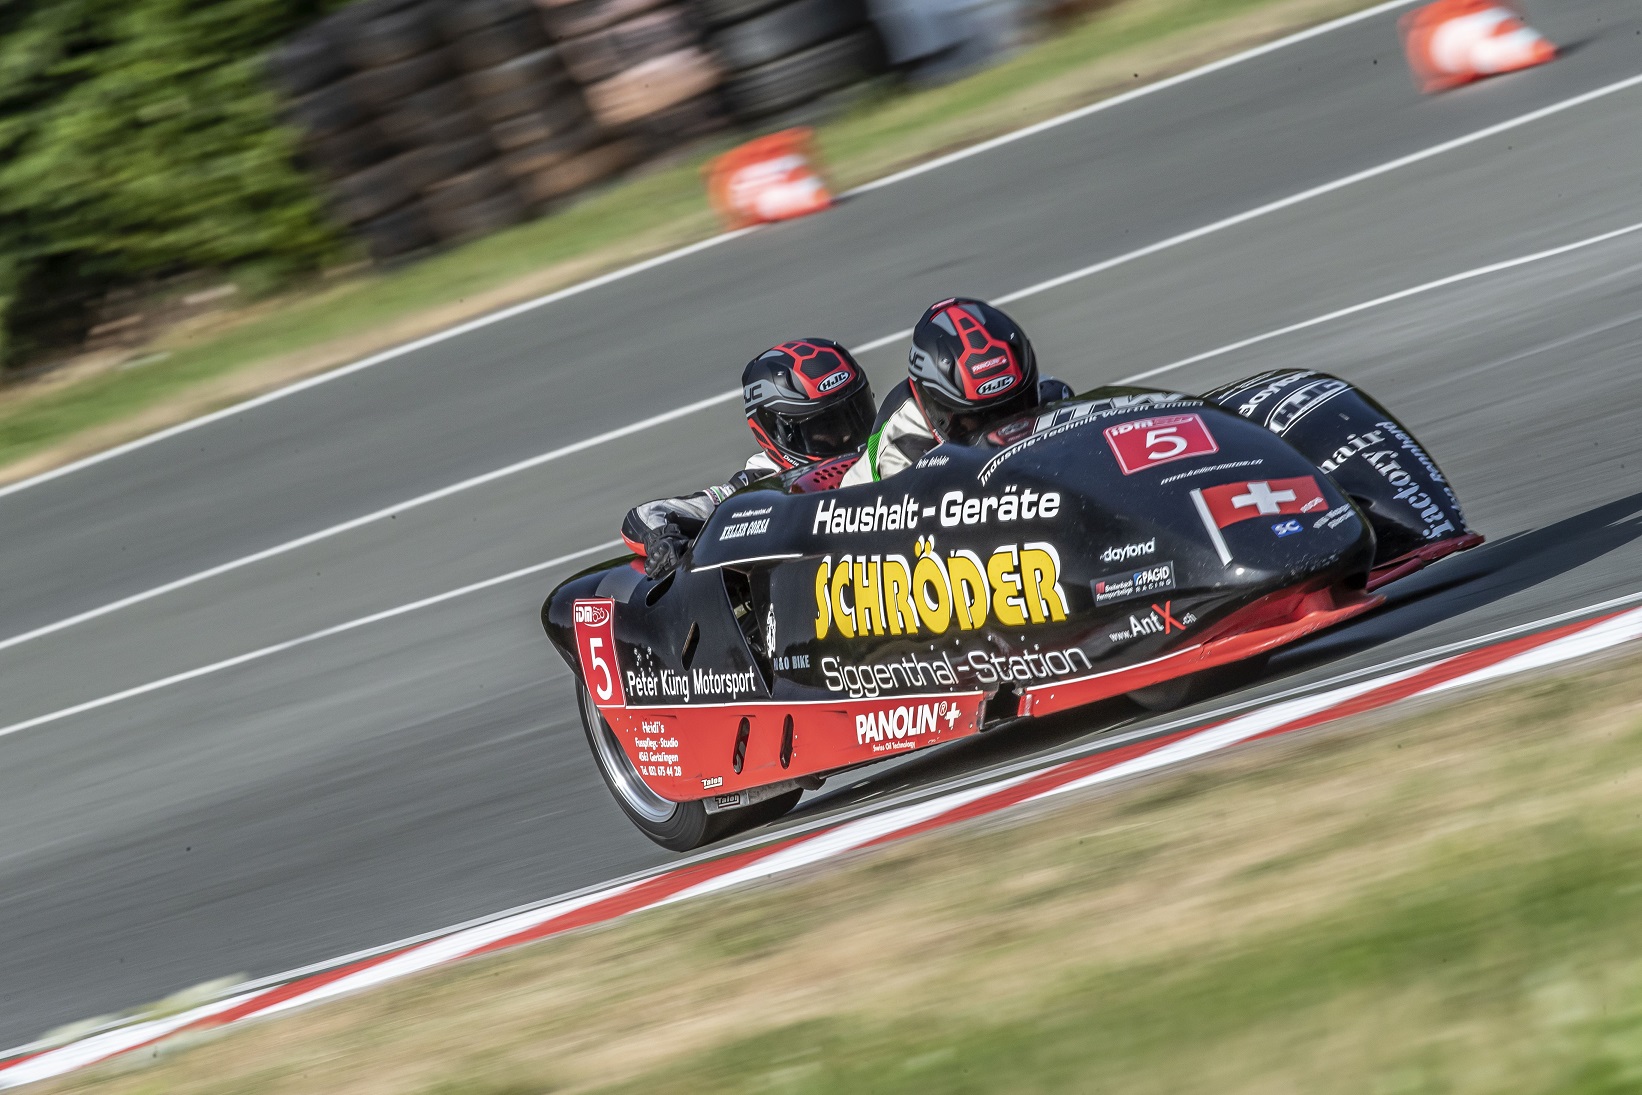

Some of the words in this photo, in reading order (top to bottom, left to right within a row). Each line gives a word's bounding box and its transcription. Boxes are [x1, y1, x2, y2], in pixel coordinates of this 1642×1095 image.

[821, 371, 847, 390] HJC
[981, 377, 1010, 393] HJC
[1102, 404, 1151, 419] Werth
[1145, 427, 1188, 460] 5
[1362, 450, 1455, 539] factory
[1141, 565, 1171, 585] PAGID
[814, 534, 1070, 640] SCHRÖDER
[1135, 579, 1172, 593] RACING
[589, 637, 613, 701] 5
[791, 654, 811, 670] BIKE
[627, 670, 658, 697] Peter
[660, 669, 690, 703] Küng
[692, 666, 757, 700] Motorsport
[641, 721, 665, 734] Heidi's
[872, 743, 885, 752] Swiss
[891, 739, 916, 750] Technology
